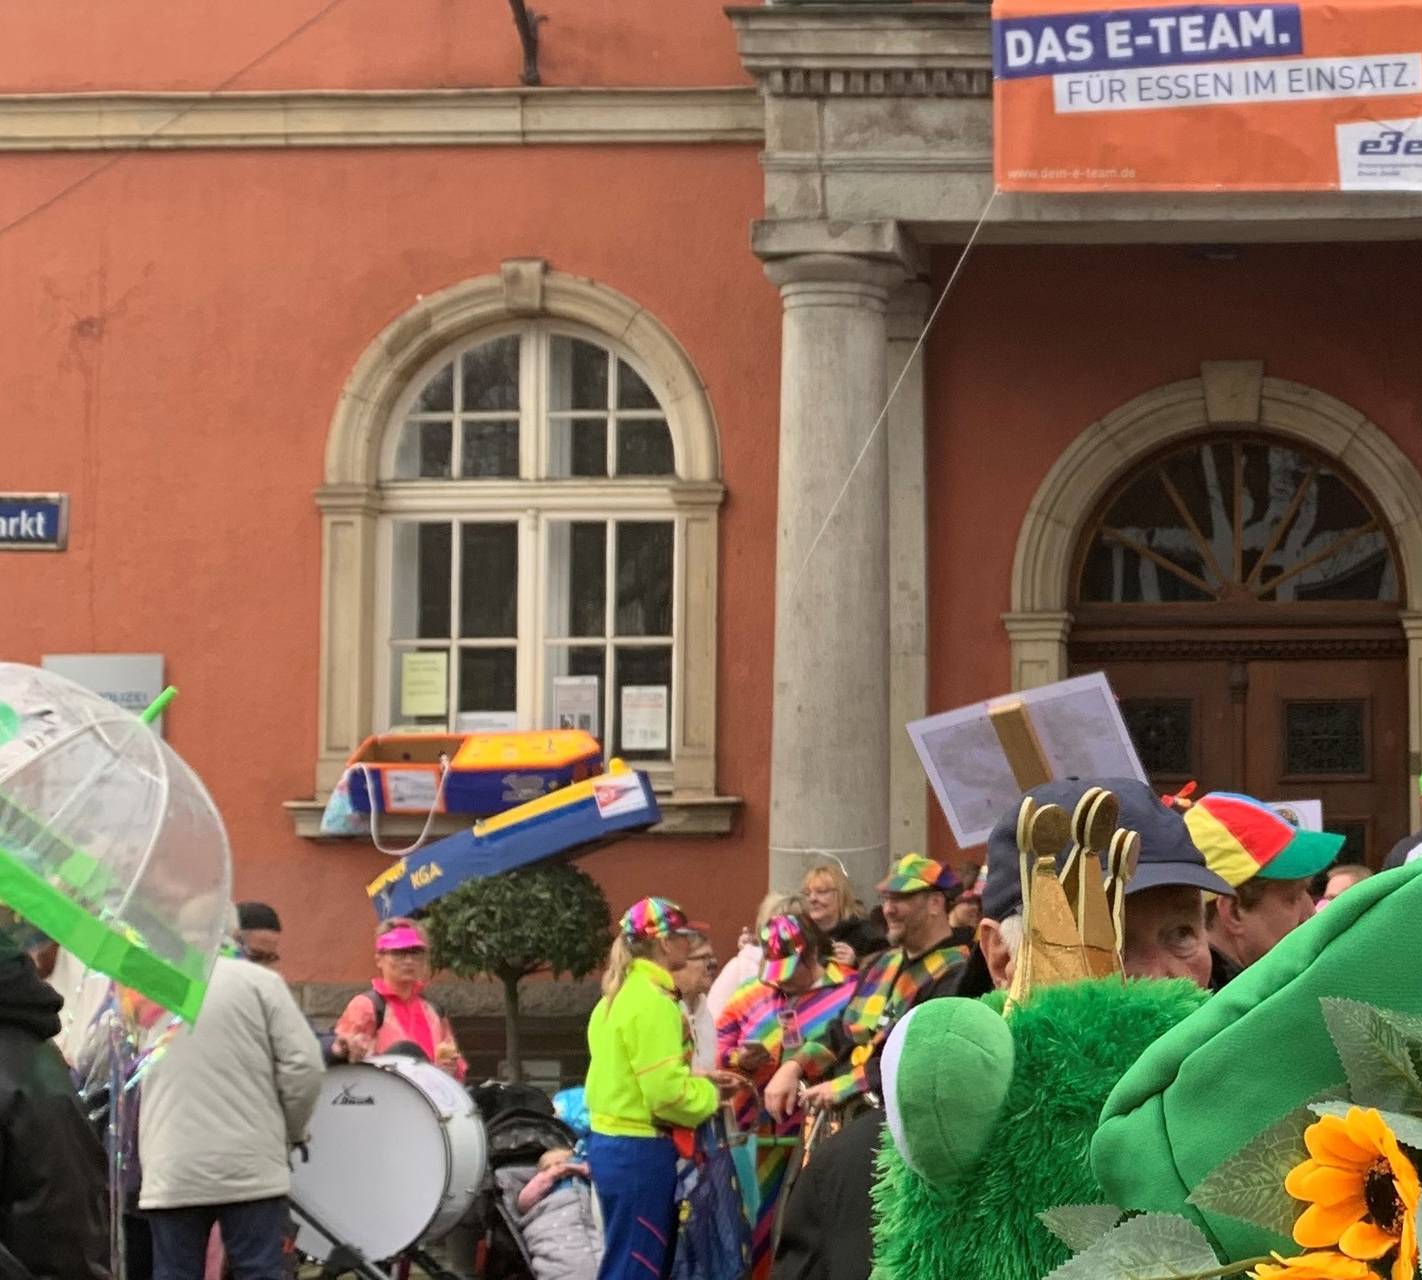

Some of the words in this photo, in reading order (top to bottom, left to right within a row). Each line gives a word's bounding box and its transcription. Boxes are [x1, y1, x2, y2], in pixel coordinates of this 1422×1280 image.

[1005, 24, 1093, 68] DAS
[1105, 9, 1291, 58] E-TEAM.
[1067, 74, 1126, 105] FÜR
[1137, 72, 1234, 101] ESSEN
[1245, 69, 1276, 95] IM
[1288, 62, 1418, 93] EINSATZ.
